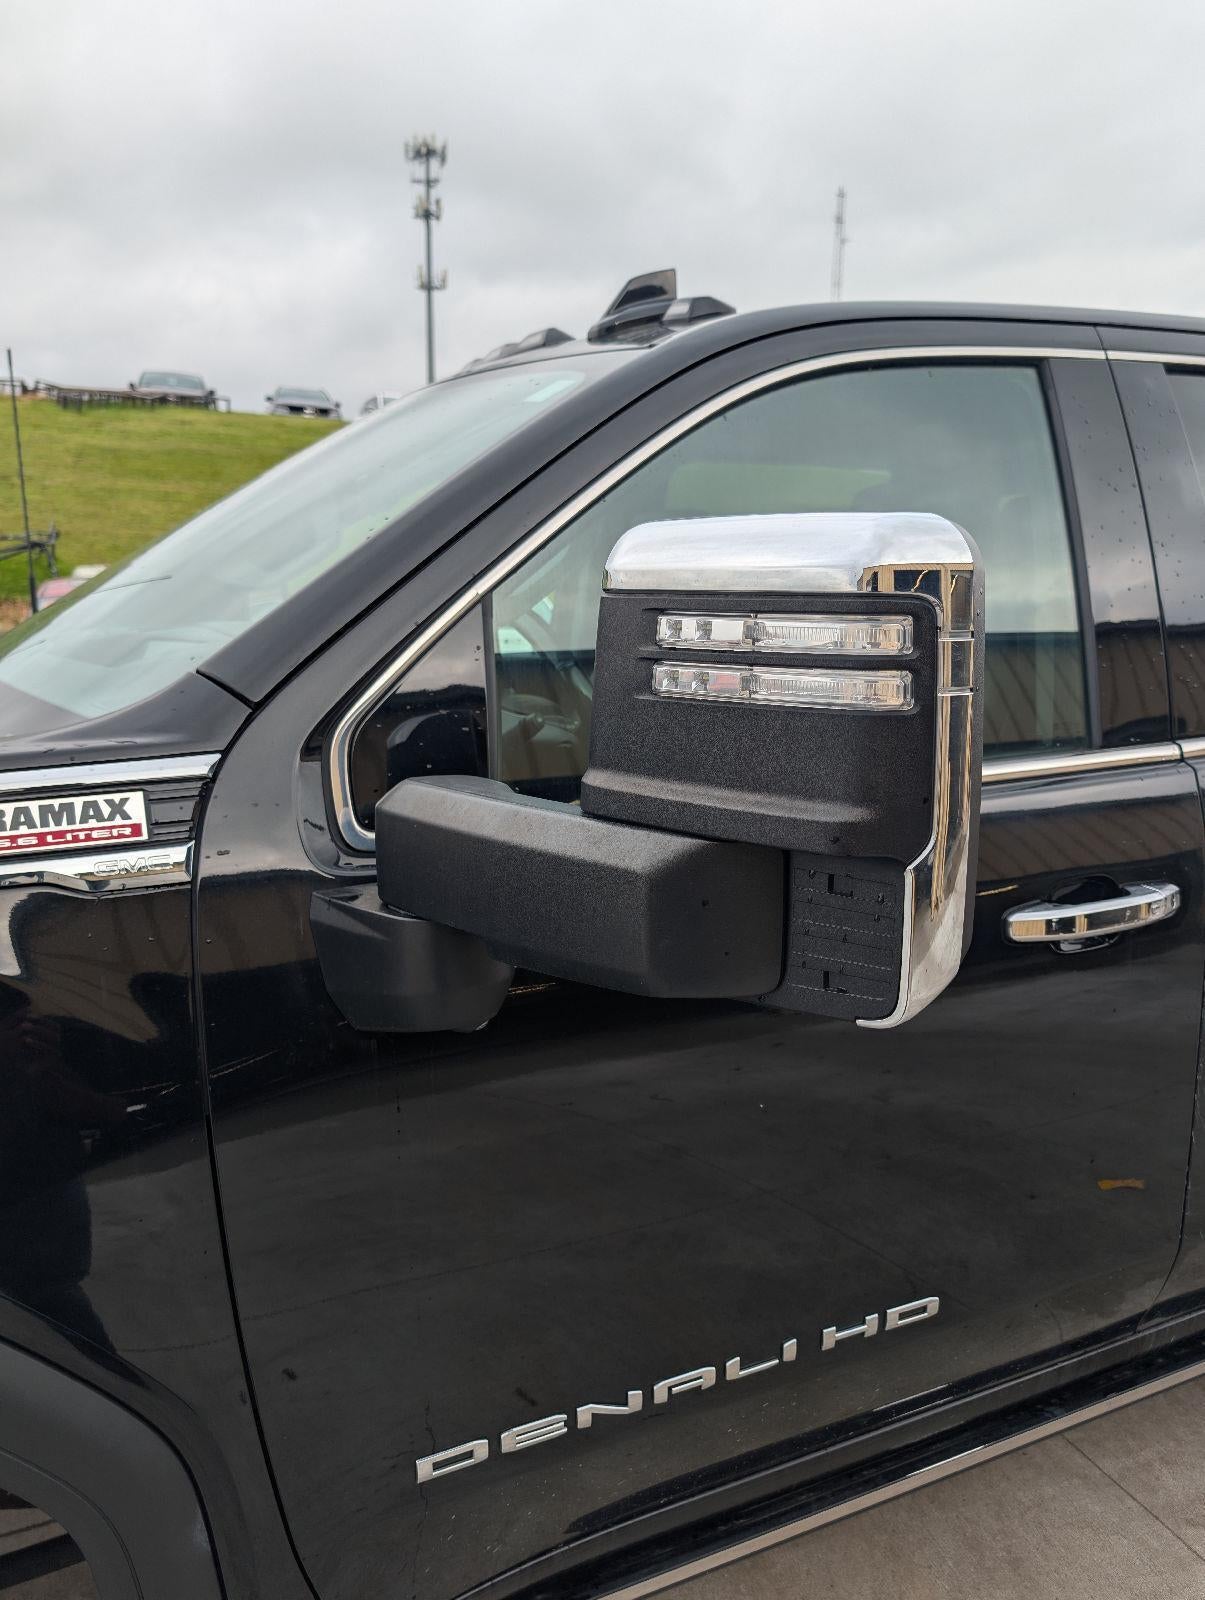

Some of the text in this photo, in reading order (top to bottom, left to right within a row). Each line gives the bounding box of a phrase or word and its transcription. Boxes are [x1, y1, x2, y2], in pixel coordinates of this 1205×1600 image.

[46, 827, 133, 843] LITER
[93, 854, 174, 877] GMC
[416, 1296, 940, 1484] DENALI HD
